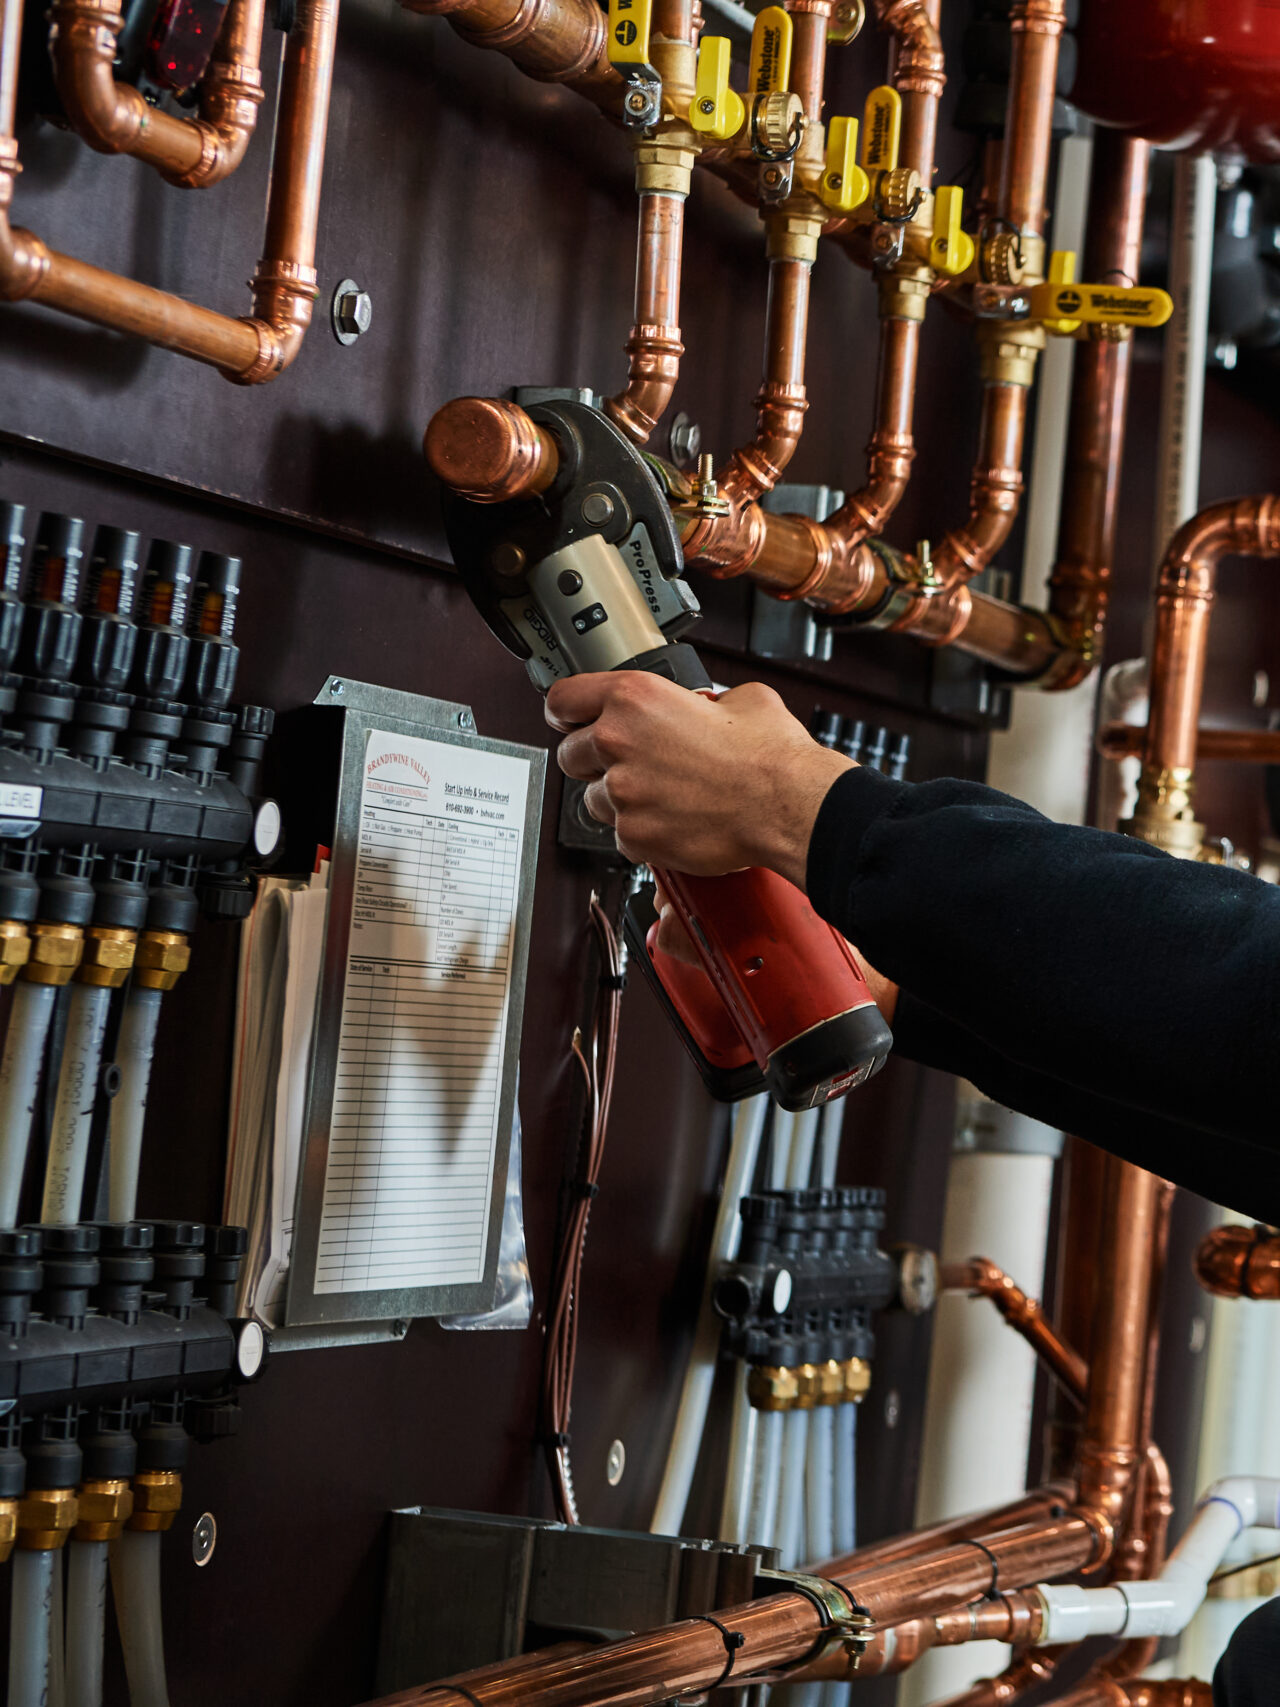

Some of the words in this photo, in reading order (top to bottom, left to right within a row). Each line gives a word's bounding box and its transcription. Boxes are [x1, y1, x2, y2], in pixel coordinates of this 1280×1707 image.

[756, 28, 775, 92] Webstone
[868, 105, 886, 166] Webstone
[630, 539, 661, 614] ProPress
[523, 607, 559, 651] RIDGID
[367, 752, 409, 775] BRANDYWINE
[410, 757, 431, 785] VALLEY
[444, 781, 456, 794] Start
[456, 784, 463, 796] Up
[464, 786, 473, 797] Info
[473, 787, 478, 798] &
[478, 788, 494, 800] Service
[494, 791, 510, 803] Record
[445, 802, 474, 816] 610-692-3900
